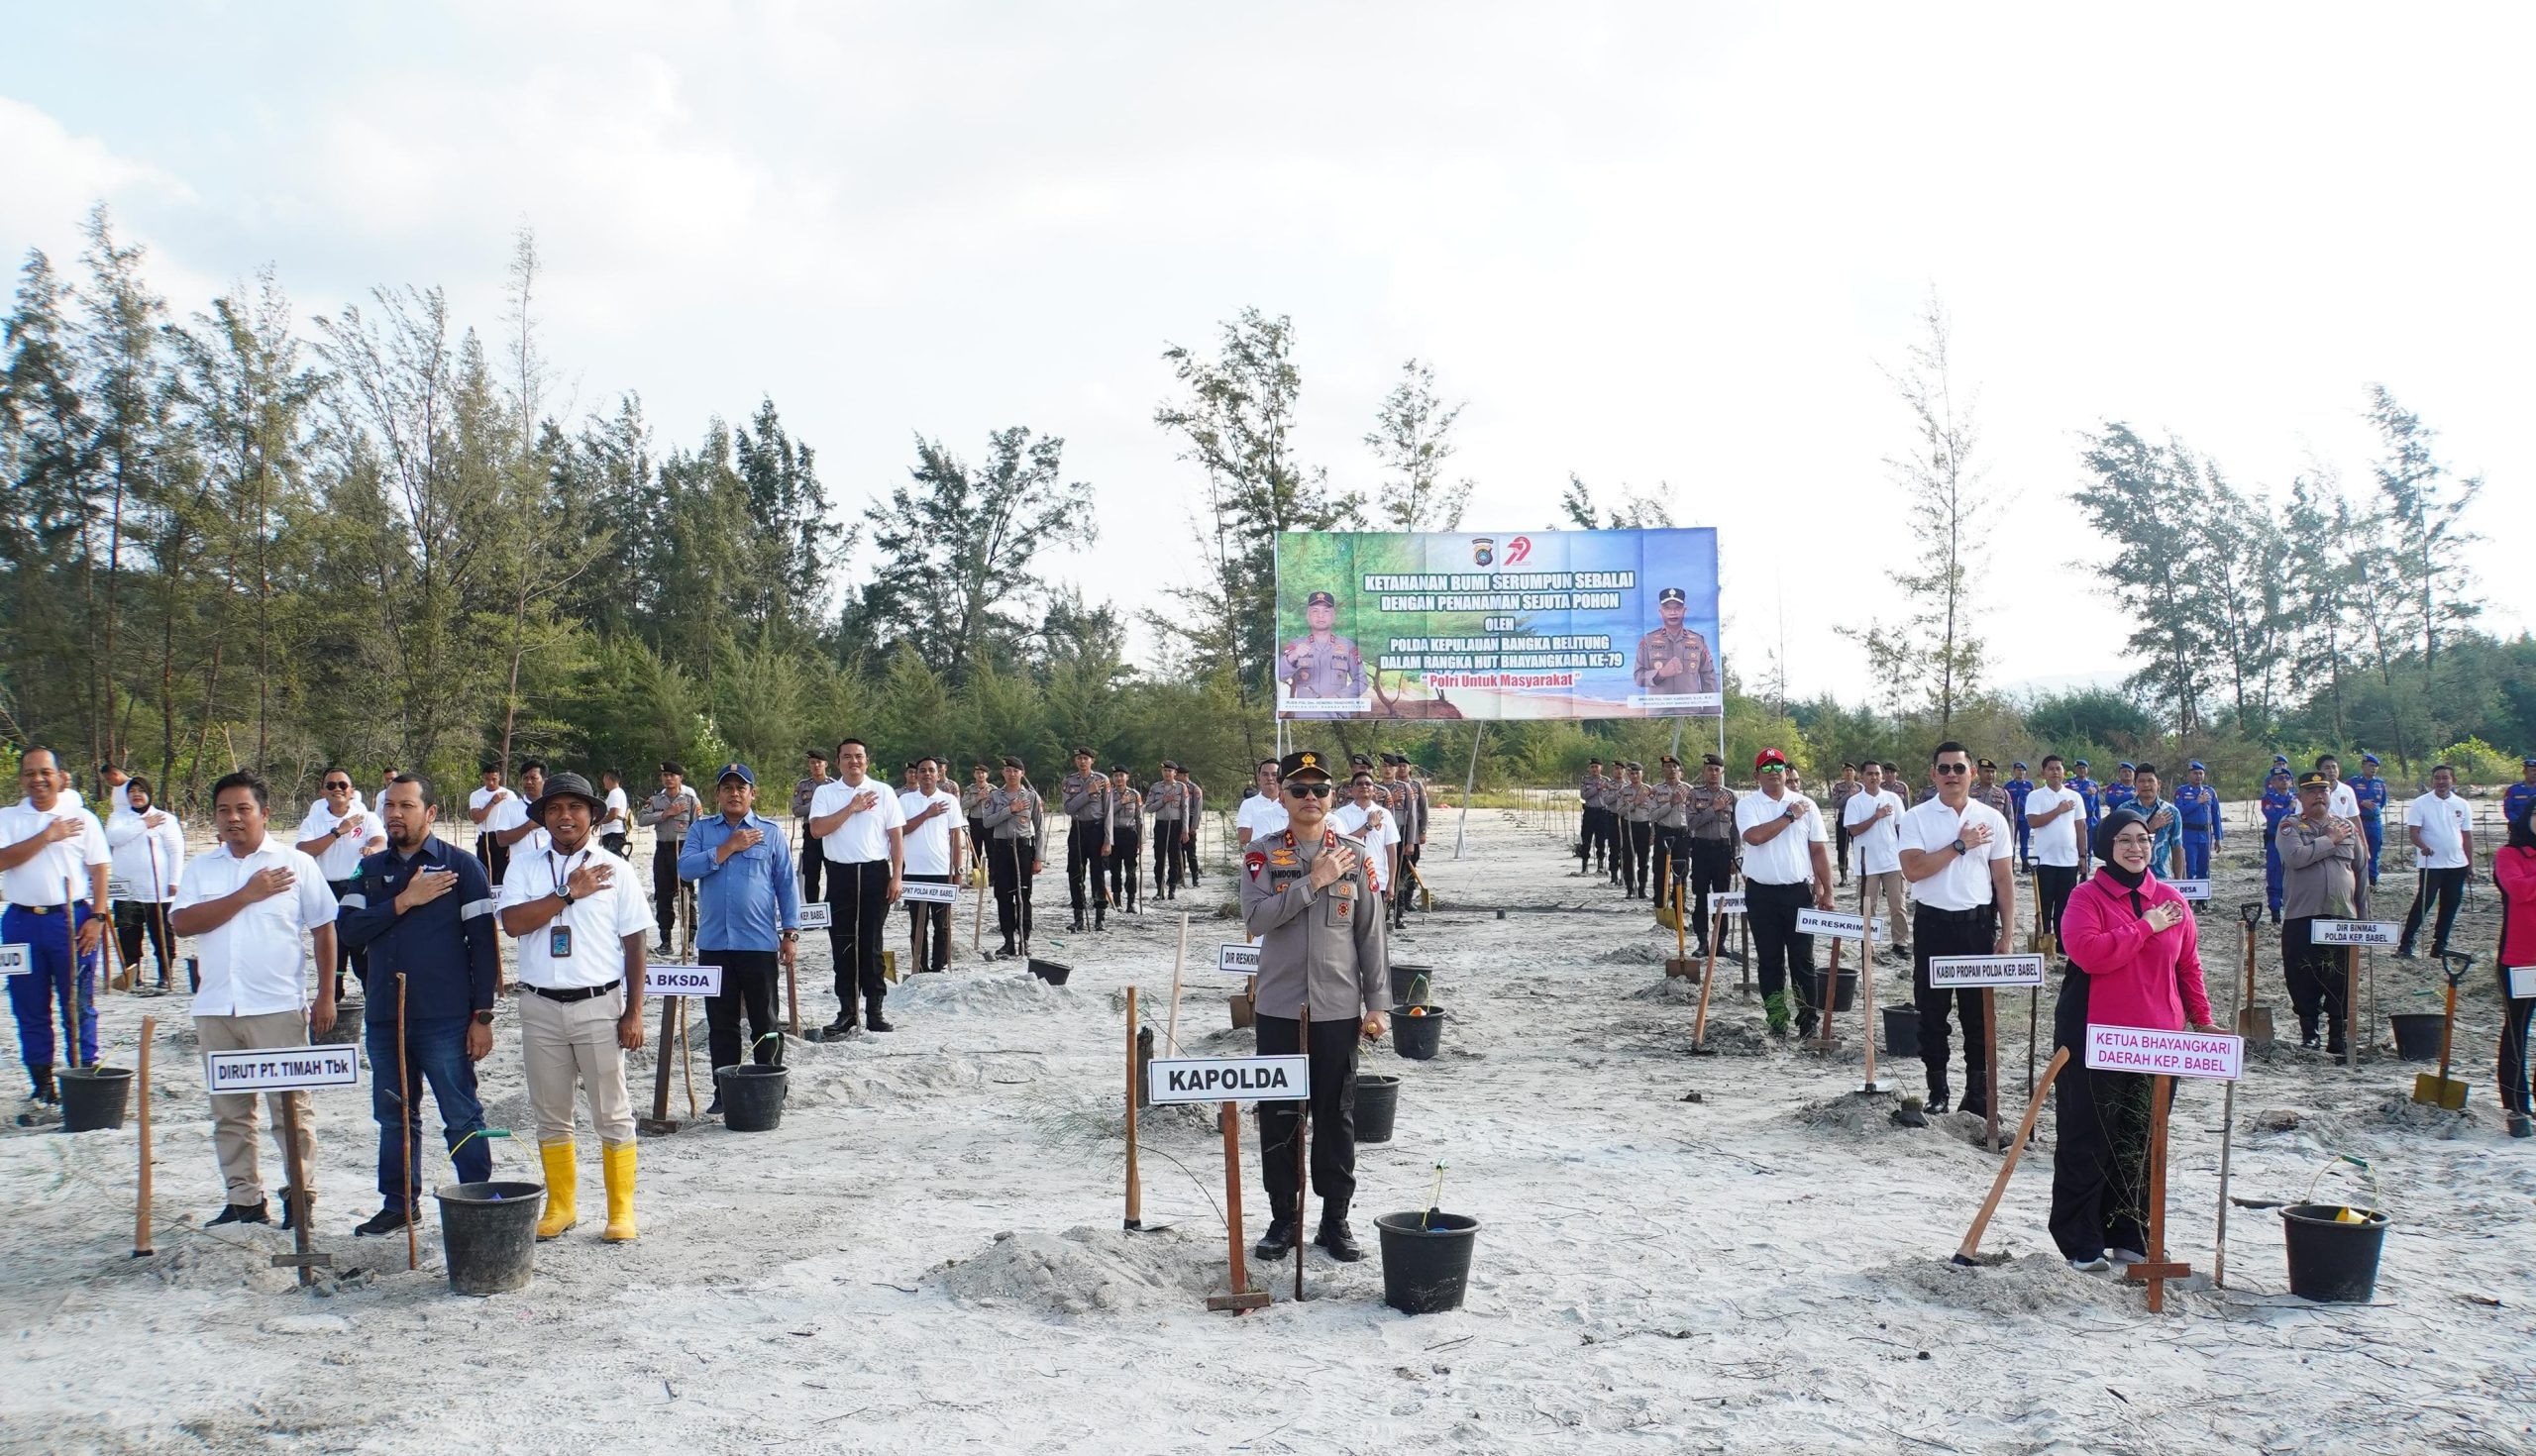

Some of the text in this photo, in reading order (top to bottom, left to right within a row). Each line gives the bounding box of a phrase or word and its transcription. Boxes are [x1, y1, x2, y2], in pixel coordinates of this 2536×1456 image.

[1364, 572, 1635, 591] KETAHANAN BUMI SERUMPUN SEBALAI
[1381, 592, 1620, 611] DENGAN PENANAMAN SEJUTA POHON
[1485, 617, 1515, 632] OLEH
[1390, 635, 1610, 652] POLDA KEPULAUAN BANGKA BELITUNG
[1380, 652, 1624, 670] DALAM RANGKA HUT BHAYANGKARA KE-79
[1461, 675, 1497, 687] Untuk
[810, 909, 825, 920] BABEL
[1802, 917, 1878, 933] DIR RESKRIMM
[2336, 923, 2378, 933] DIR BINMAS
[2324, 932, 2387, 943] POLDA KEP. BABEL
[1225, 952, 1235, 964] DIR
[1936, 963, 2038, 979] KABID PROPAM POLDA KEP. BABEL
[657, 975, 709, 988] BKSDA
[2096, 1032, 2231, 1055] KETUA BHAYANGKARI
[2098, 1050, 2227, 1072] DAERAH KEP. BABEL
[219, 1059, 349, 1080] DIRUT PT. TIMAH Tbk
[1169, 1068, 1288, 1091] KAPOLDA
